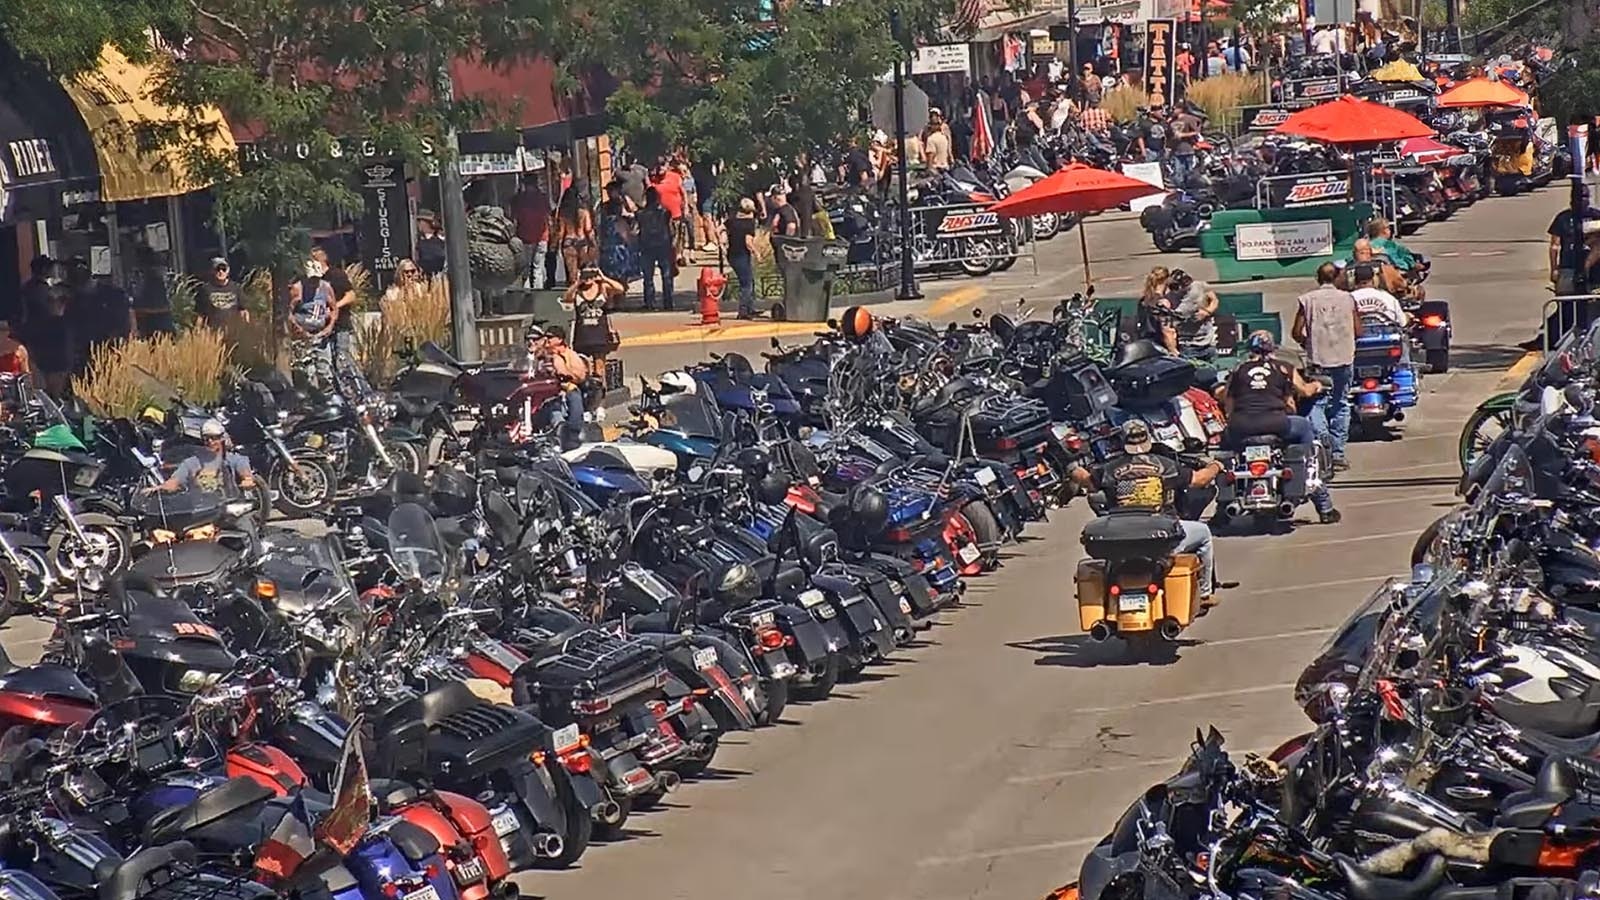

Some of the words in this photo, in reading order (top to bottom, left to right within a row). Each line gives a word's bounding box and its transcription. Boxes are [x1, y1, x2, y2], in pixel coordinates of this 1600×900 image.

[1149, 24, 1169, 106] TATTO
[1250, 113, 1291, 126] AMSOI
[8, 138, 55, 176] RIDER
[1285, 182, 1347, 202] AMSOIL
[377, 188, 391, 258] STURGIS
[938, 212, 997, 232] AMSOIL
